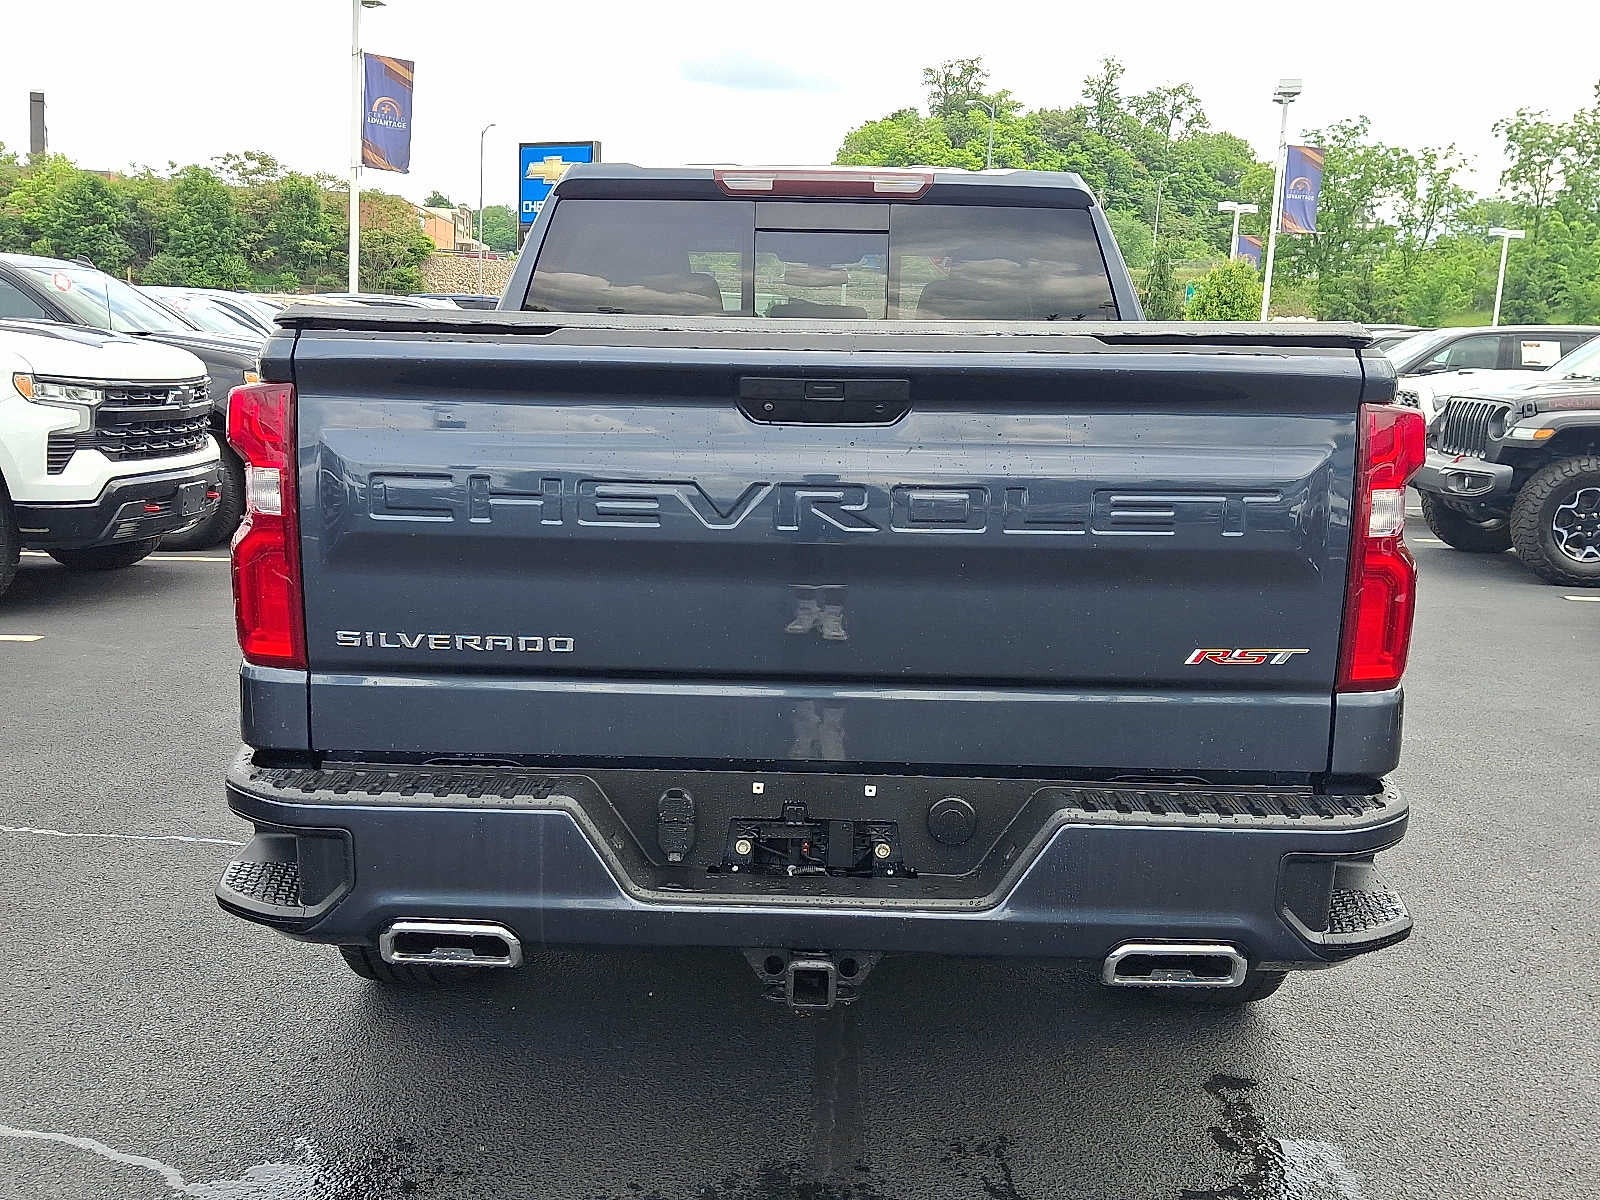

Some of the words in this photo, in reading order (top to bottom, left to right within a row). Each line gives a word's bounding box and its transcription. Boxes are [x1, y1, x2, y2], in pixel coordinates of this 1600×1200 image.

[367, 115, 408, 129] ADVANTAGE
[368, 470, 1285, 538] CHEVROLET
[335, 629, 576, 653] SILVERADO
[1184, 647, 1311, 666] RST
